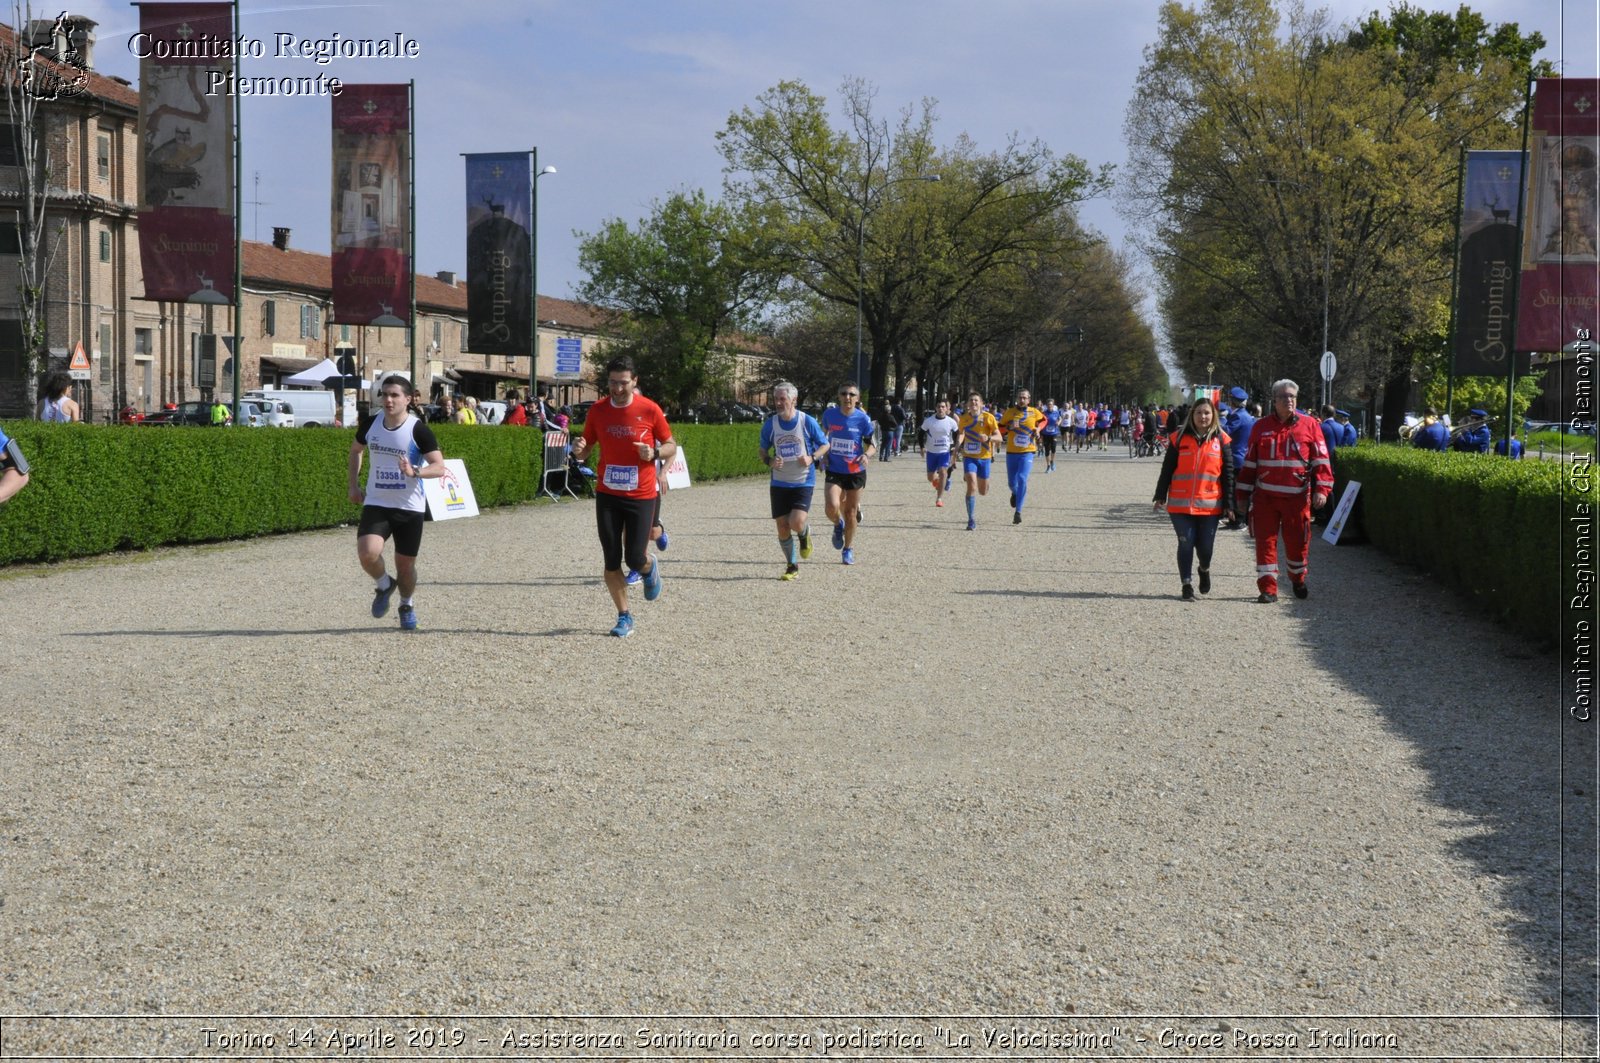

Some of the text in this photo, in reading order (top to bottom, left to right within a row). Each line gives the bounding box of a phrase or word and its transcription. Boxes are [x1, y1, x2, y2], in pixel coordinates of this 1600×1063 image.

[154, 232, 219, 256] Stupinigi
[482, 248, 511, 343] Stupinigi
[1474, 259, 1512, 362] Stupinigi
[380, 471, 400, 480] 3358
[611, 471, 630, 481] 1390
